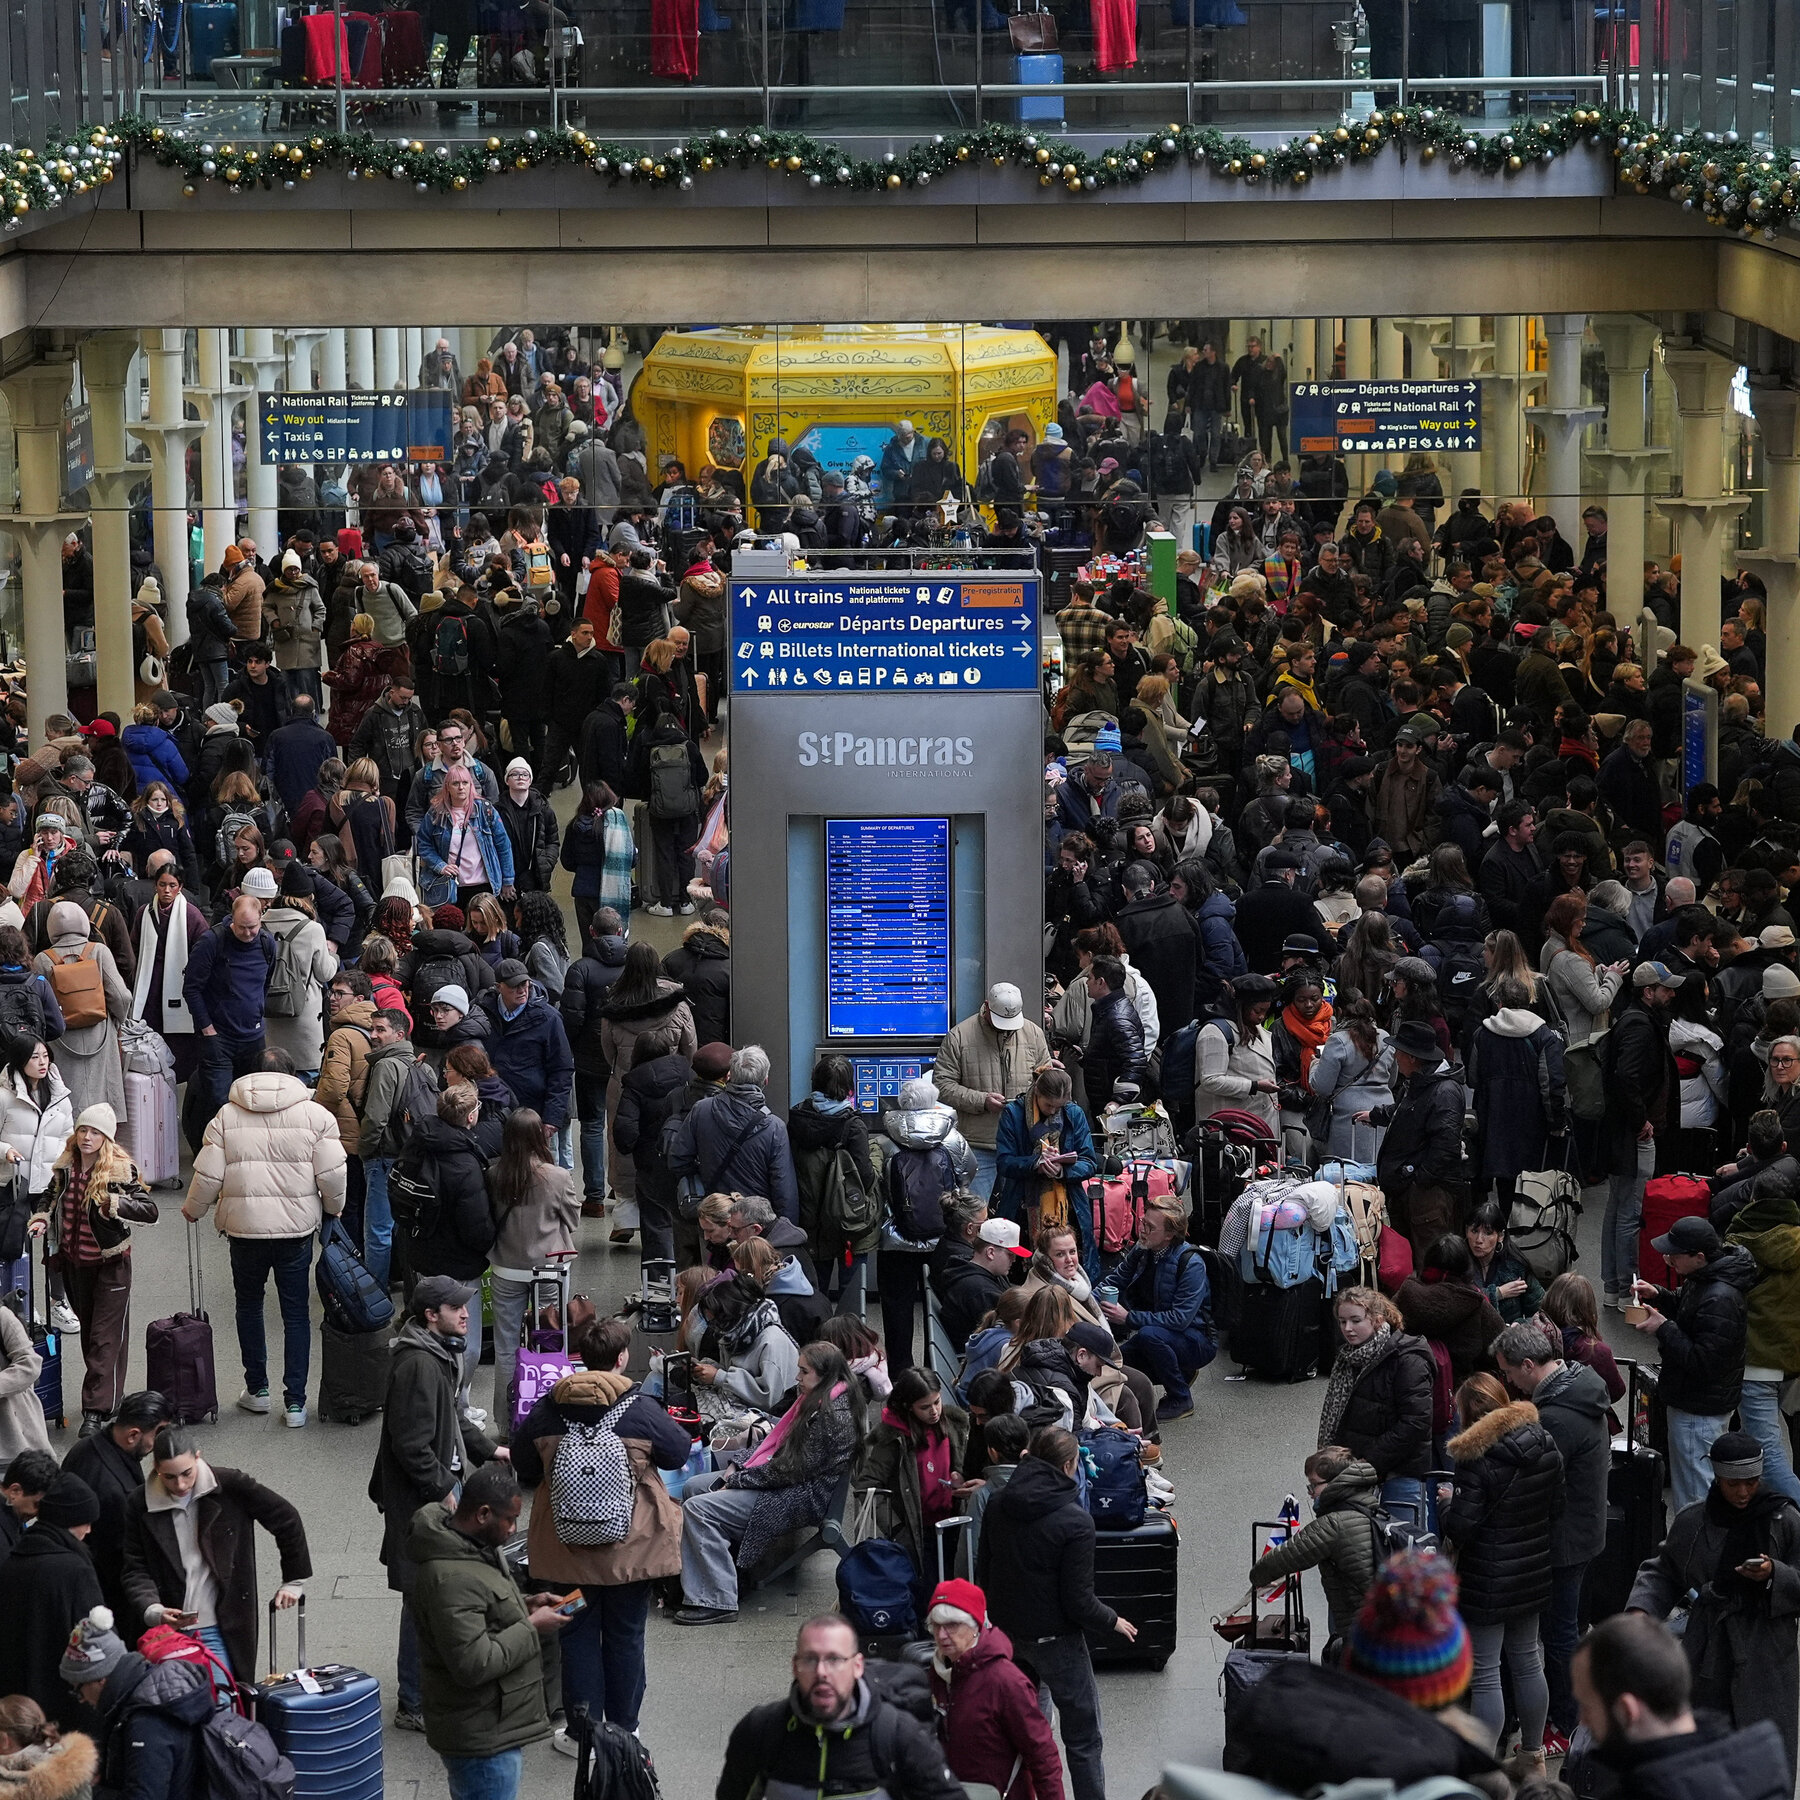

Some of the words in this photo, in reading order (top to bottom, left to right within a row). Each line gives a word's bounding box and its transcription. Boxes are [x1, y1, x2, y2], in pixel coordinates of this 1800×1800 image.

[1359, 383, 1399, 396] Départs
[1402, 384, 1459, 396] Departures
[282, 396, 325, 407] National
[328, 396, 348, 407] Rail
[1394, 402, 1437, 412] National
[1440, 401, 1459, 412] Rail
[283, 414, 306, 426] Way
[308, 415, 324, 424] out
[1419, 419, 1441, 431] Way
[1444, 420, 1460, 429] out
[284, 431, 311, 442] Taxis
[767, 589, 791, 604] All
[794, 588, 843, 604] trains
[849, 586, 882, 595] National
[884, 586, 911, 595] tickets
[962, 587, 1021, 595] Pre-registration
[849, 595, 864, 604] and
[865, 595, 904, 605] platforms
[1013, 595, 1021, 604] A
[793, 621, 834, 630] eurostar
[840, 615, 905, 634] Départs
[910, 615, 1004, 634] Departures
[779, 642, 833, 658] Billets
[837, 642, 944, 658] International
[949, 642, 1005, 658] tickets
[886, 770, 973, 778] INTERNATIONAL
